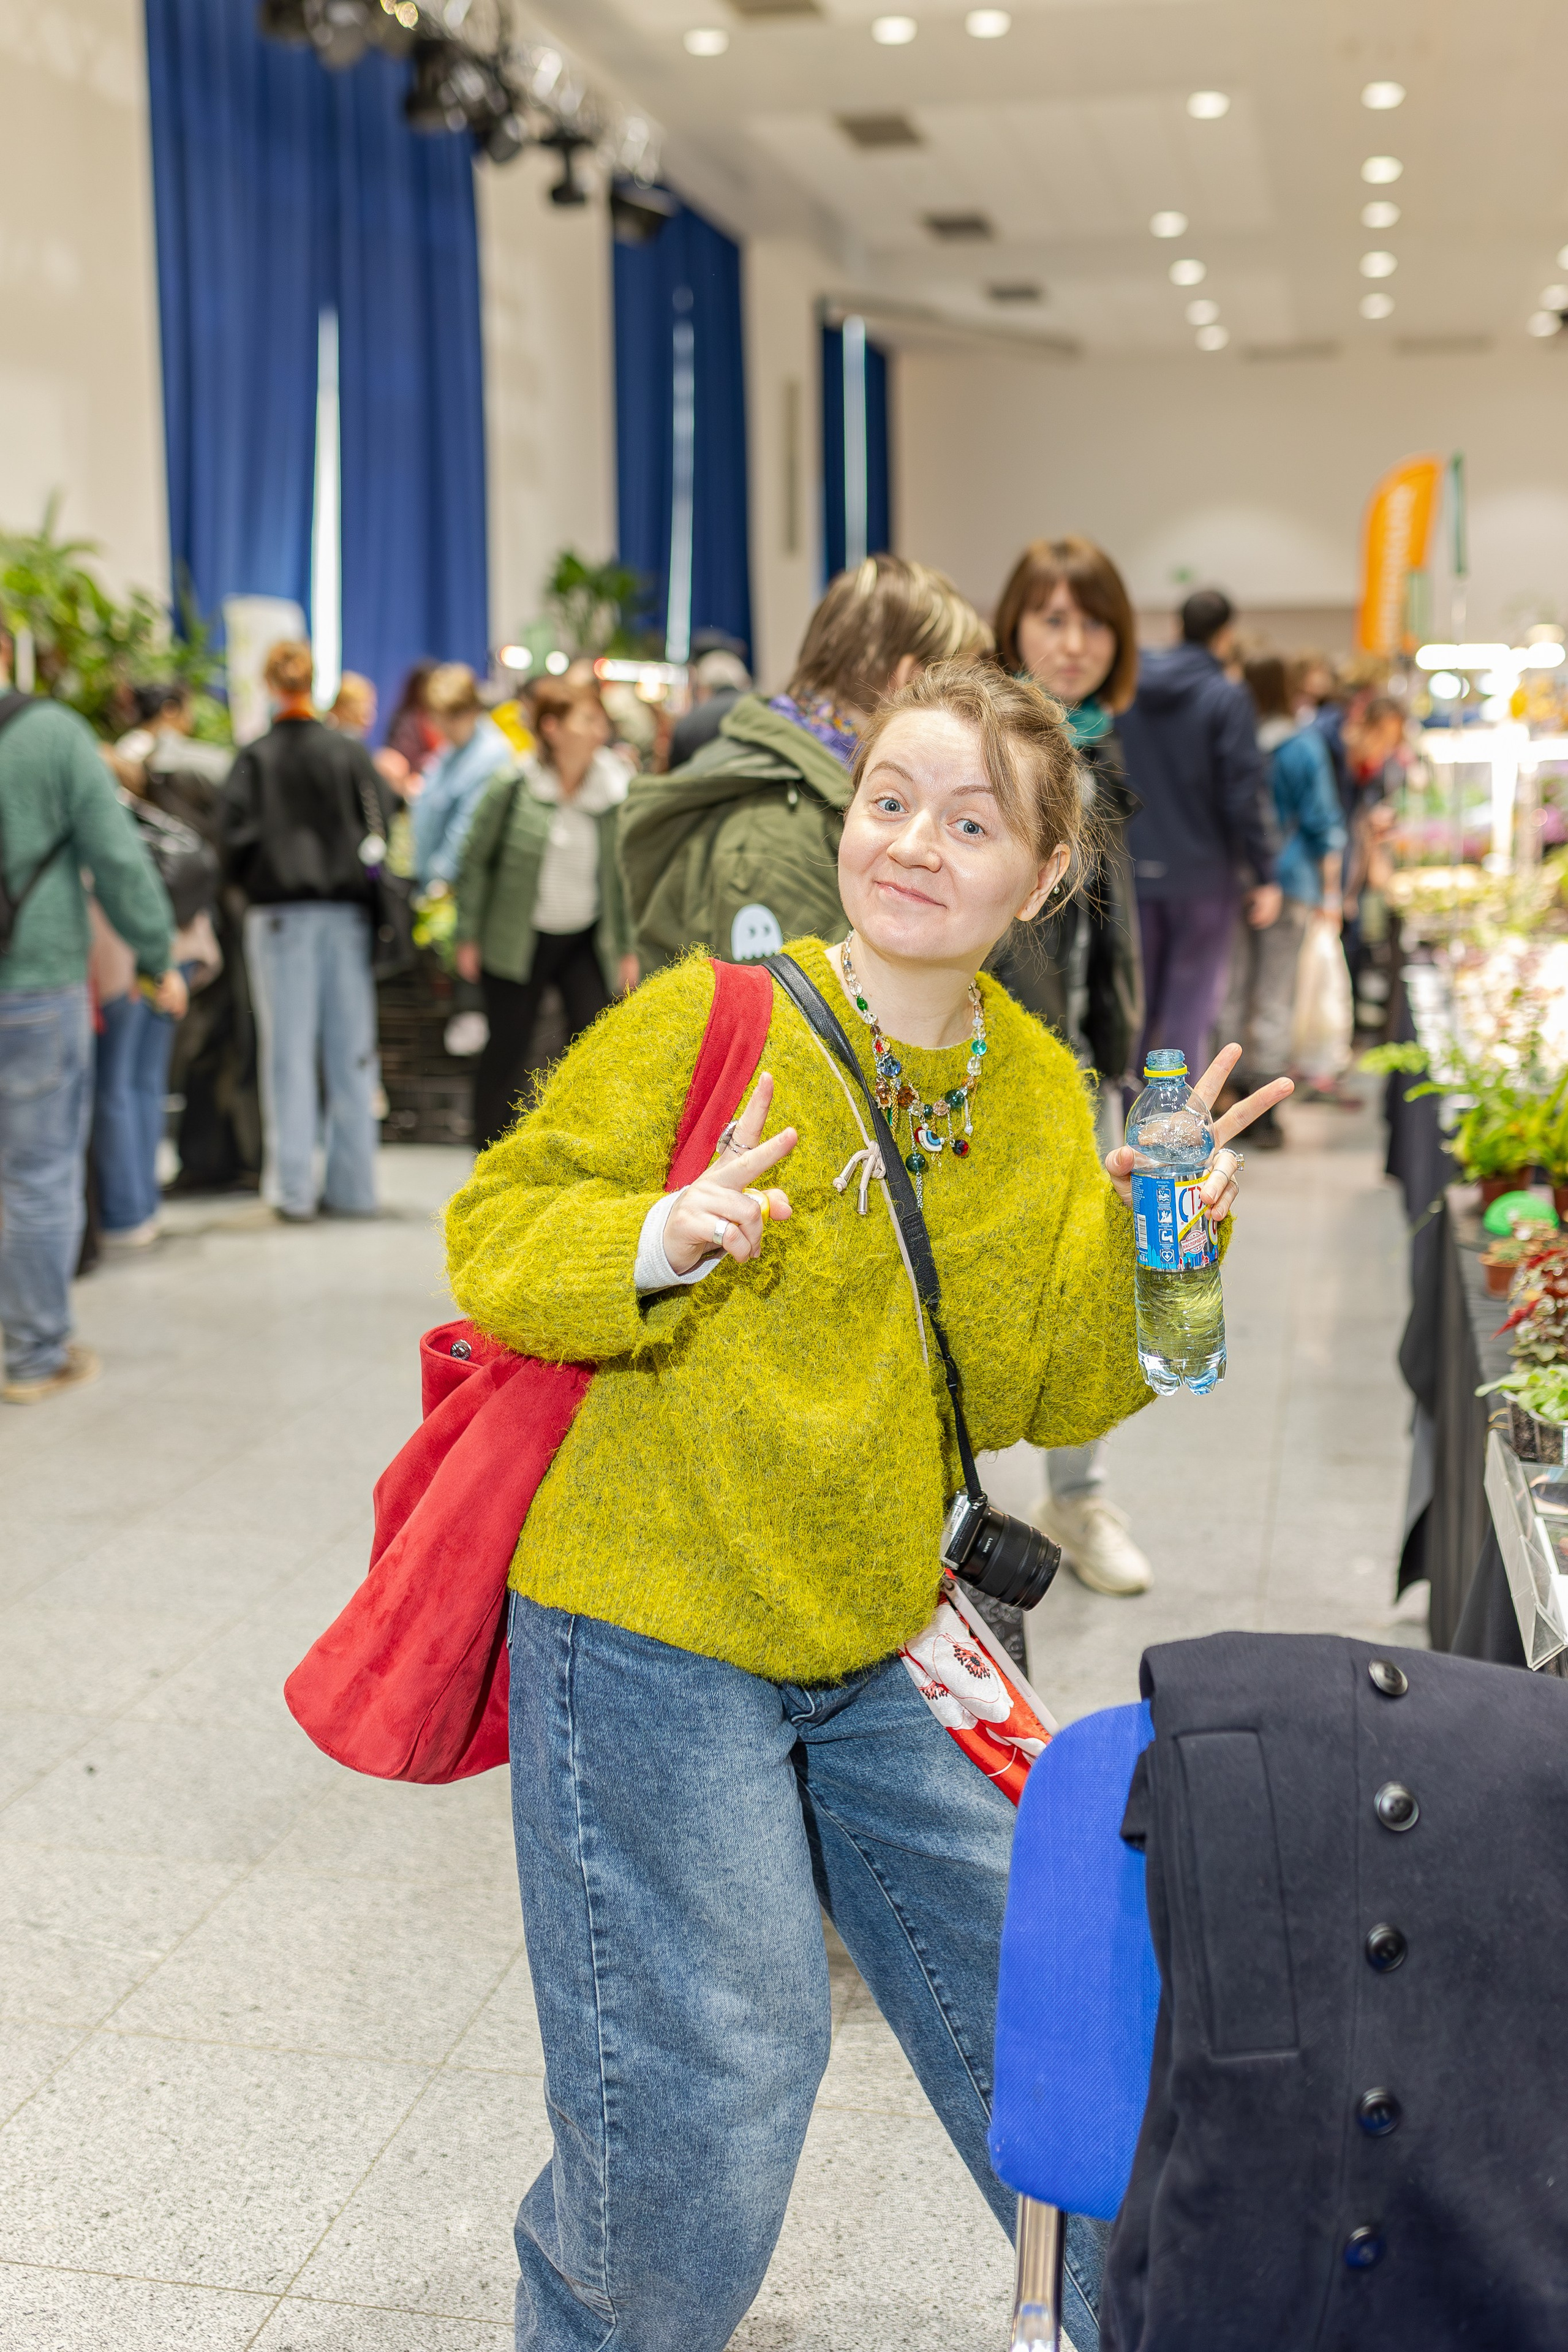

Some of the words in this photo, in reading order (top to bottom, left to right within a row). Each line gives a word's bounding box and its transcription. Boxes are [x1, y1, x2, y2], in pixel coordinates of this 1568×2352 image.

[1178, 1186, 1203, 1223] СТЭ
[1182, 1234, 1207, 1250] КИСЛОРОДНАЯ
[982, 1537, 993, 1553] LUMIX
